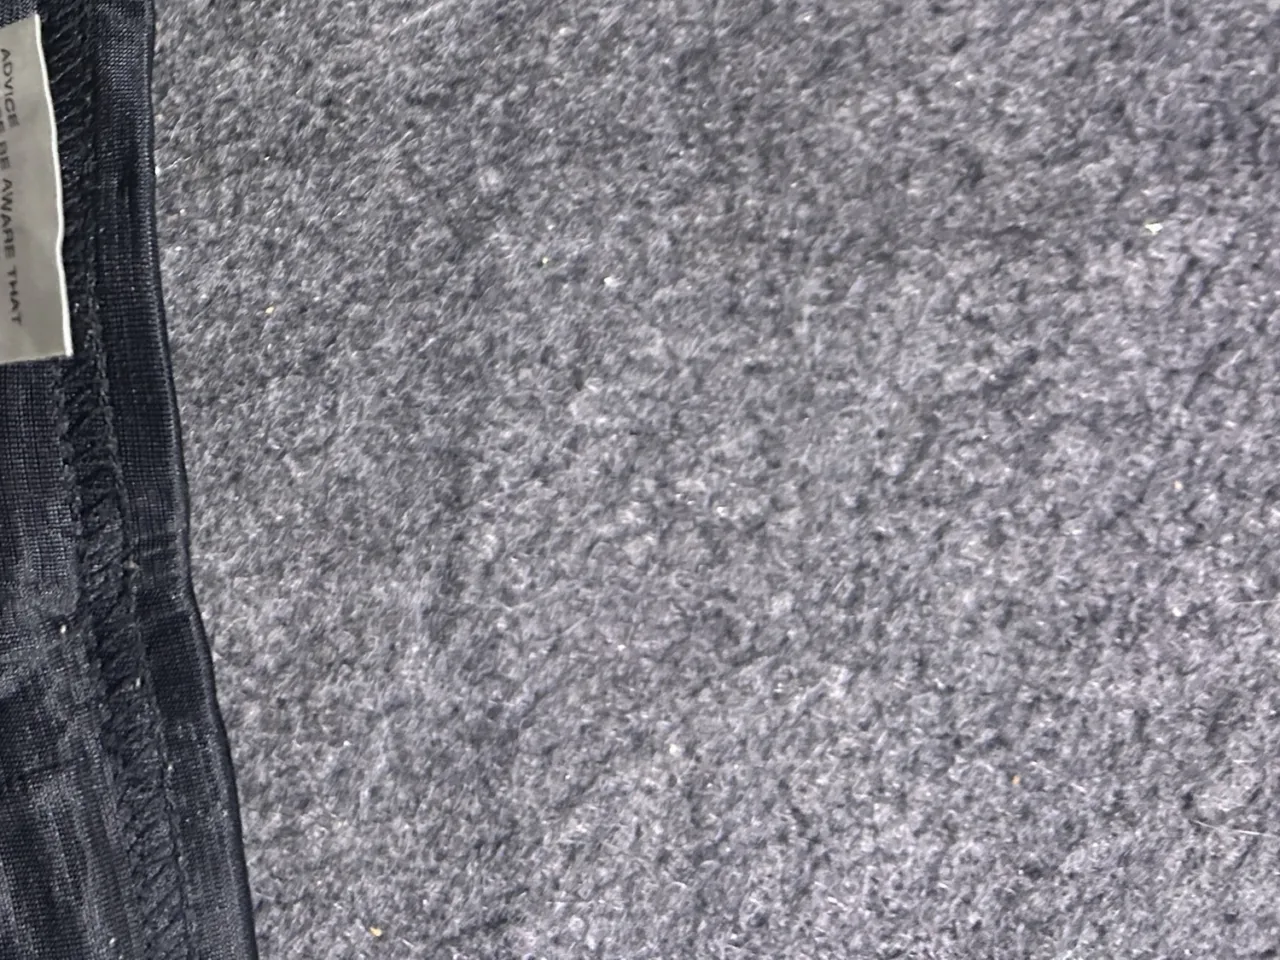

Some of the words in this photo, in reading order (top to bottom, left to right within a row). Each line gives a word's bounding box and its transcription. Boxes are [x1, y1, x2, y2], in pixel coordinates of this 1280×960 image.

[1, 49, 20, 128] ADVICE
[0, 178, 16, 260] AWARE
[6, 266, 22, 326] THAT
